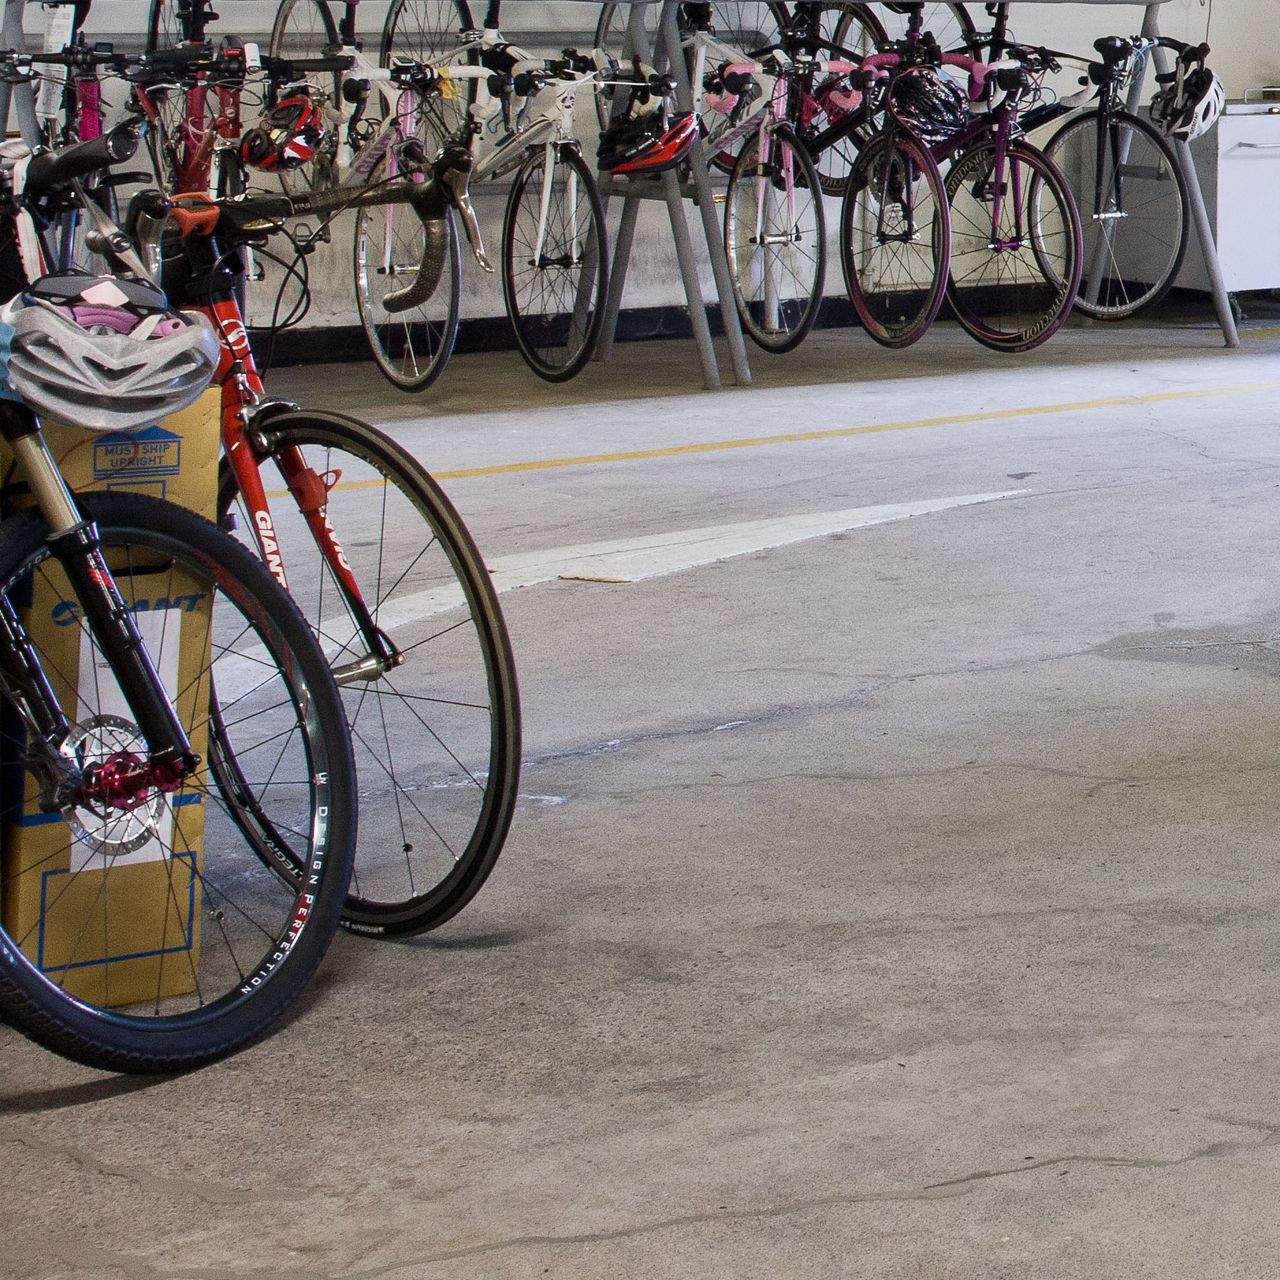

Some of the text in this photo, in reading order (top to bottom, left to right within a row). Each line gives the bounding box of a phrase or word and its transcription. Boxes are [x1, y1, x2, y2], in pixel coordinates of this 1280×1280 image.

[142, 443, 170, 453] SHIP
[240, 806, 329, 996] DESIGN PERFECTION
